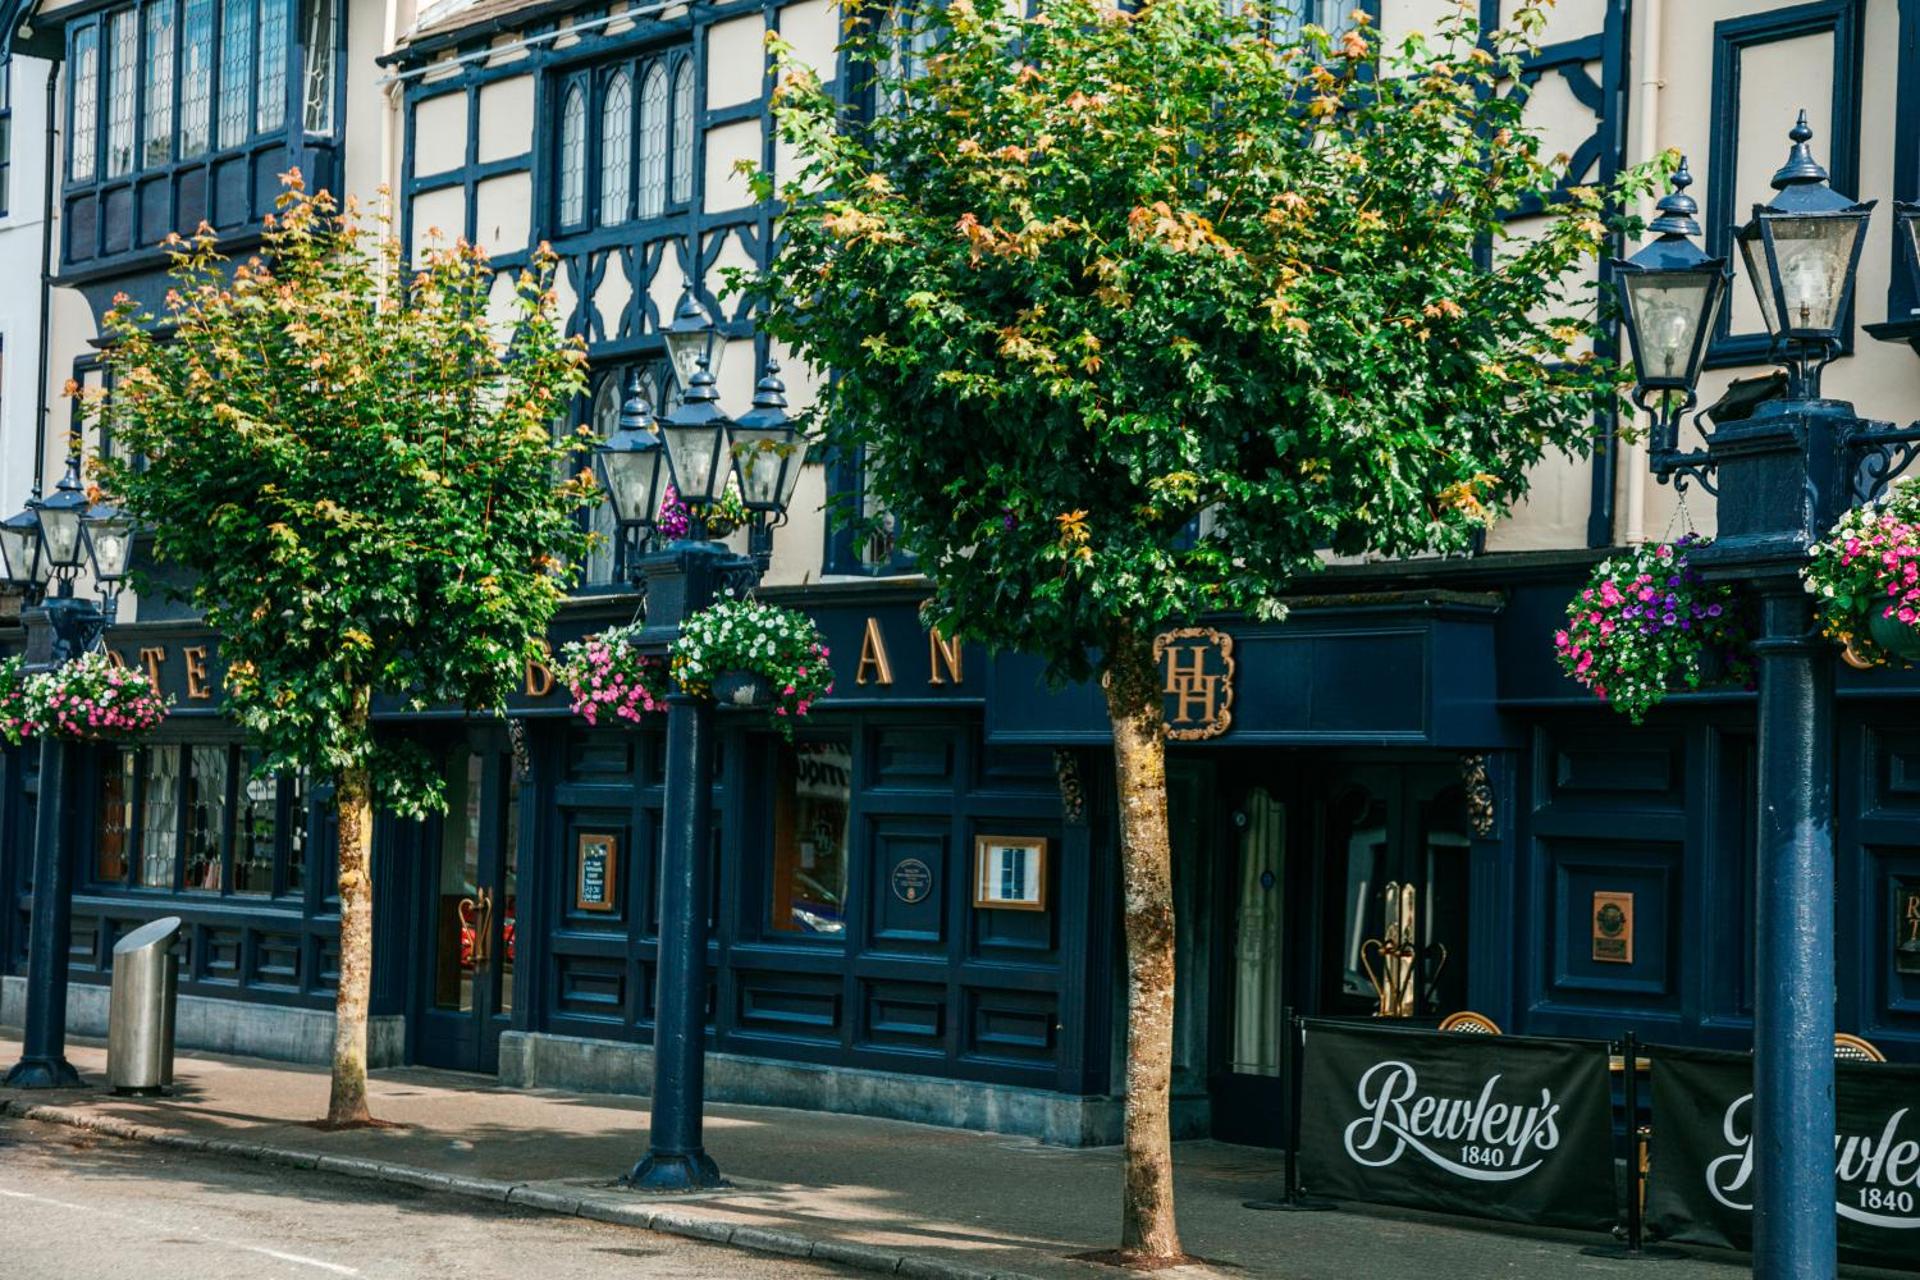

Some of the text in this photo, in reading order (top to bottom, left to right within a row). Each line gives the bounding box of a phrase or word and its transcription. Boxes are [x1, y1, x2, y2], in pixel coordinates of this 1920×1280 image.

[108, 646, 211, 699] TE
[1344, 1060, 1560, 1181] Bewley's
[1461, 1146, 1505, 1167] 1840
[1859, 1186, 1914, 1213] 1840
